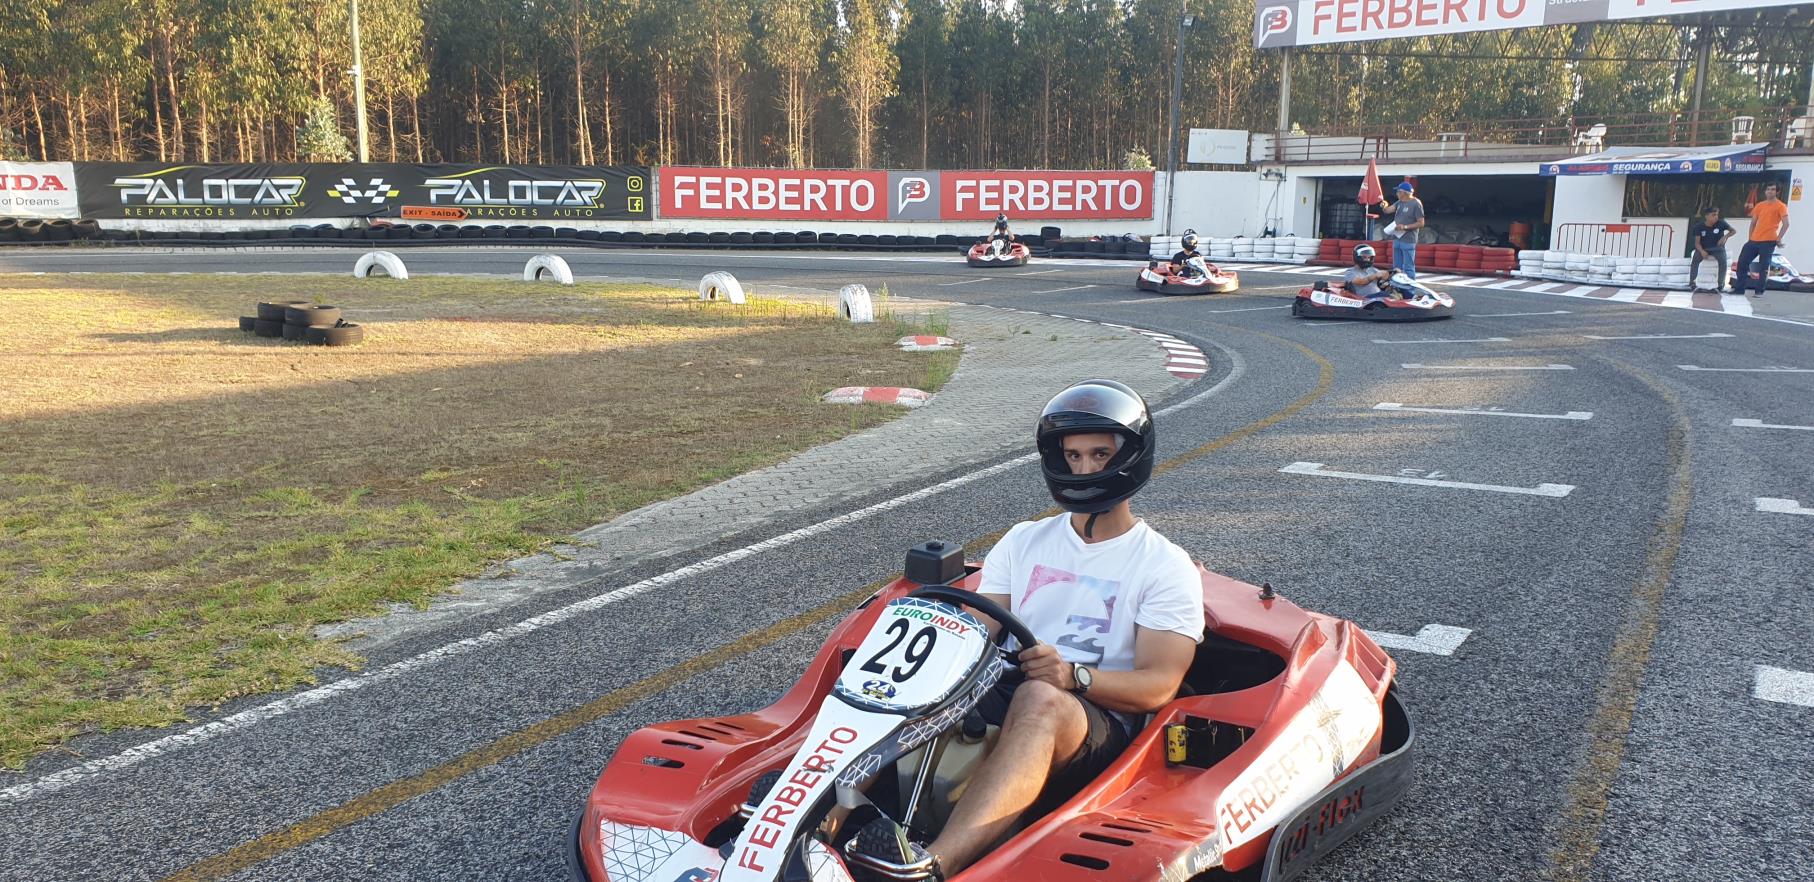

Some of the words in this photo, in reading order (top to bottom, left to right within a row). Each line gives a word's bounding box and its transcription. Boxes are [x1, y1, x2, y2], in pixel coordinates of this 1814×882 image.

[1612, 163, 1671, 172] SEGURANÇA
[16, 197, 60, 206] Dreams
[114, 178, 303, 205] PALOCAR
[424, 179, 604, 206] PALOCAR
[674, 175, 875, 212] FERBERTO
[956, 179, 1143, 212] FERBERTO
[124, 207, 236, 217] REPARAÇÕES
[251, 208, 293, 216] AUTO
[431, 209, 457, 217] SAÍDA
[466, 207, 539, 217] ARAÇÕES
[553, 209, 593, 217] AUTO
[892, 607, 972, 635] EUROINDY
[859, 617, 938, 683] 29
[738, 726, 859, 873] FERBERTO
